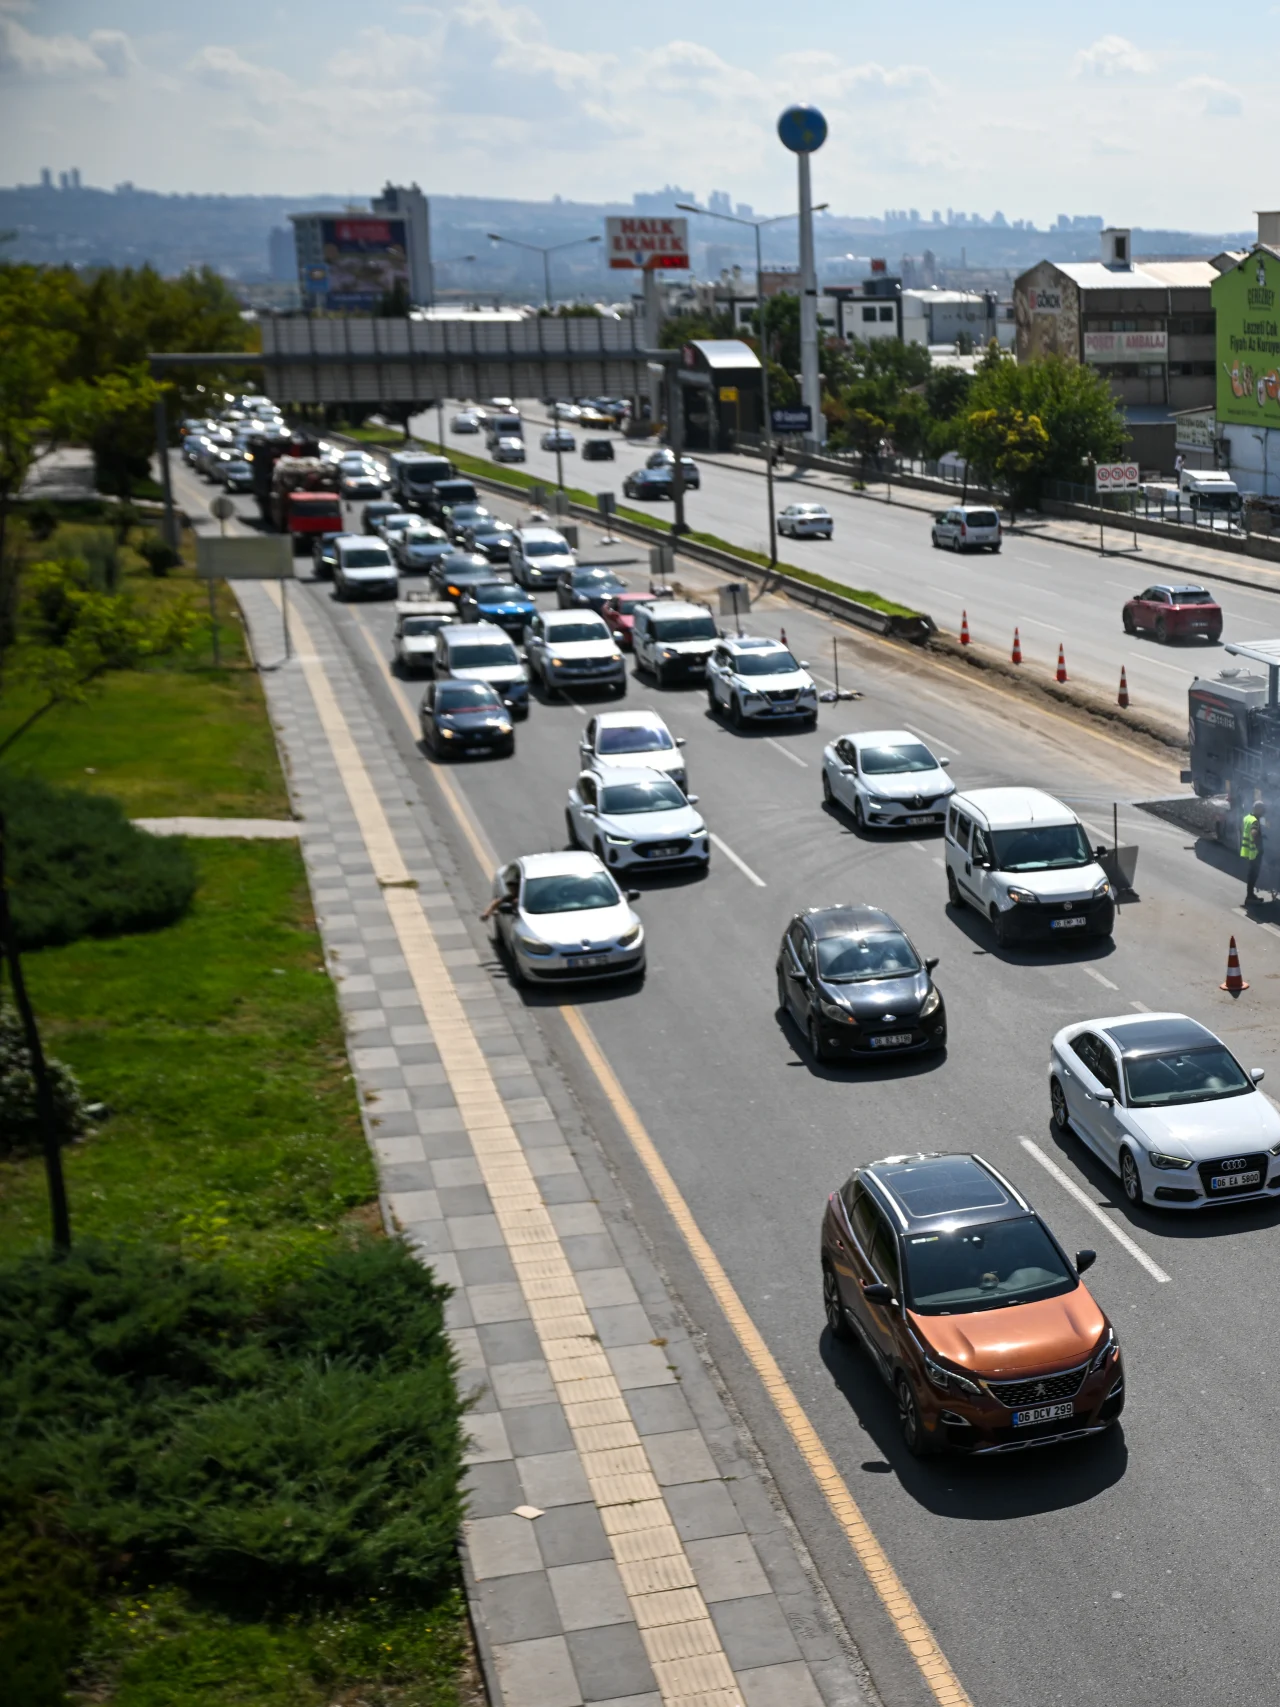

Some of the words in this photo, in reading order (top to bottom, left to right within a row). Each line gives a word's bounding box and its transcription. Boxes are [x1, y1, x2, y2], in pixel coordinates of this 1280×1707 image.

[622, 219, 674, 234] HALK
[613, 236, 684, 251] EKMEK
[1126, 334, 1166, 349] AMBALAJ
[1217, 1179, 1226, 1187] 06
[1229, 1176, 1238, 1186] EA
[1018, 1411, 1030, 1423] 06
[1033, 1407, 1051, 1420] DCV
[1054, 1403, 1072, 1416] 299
